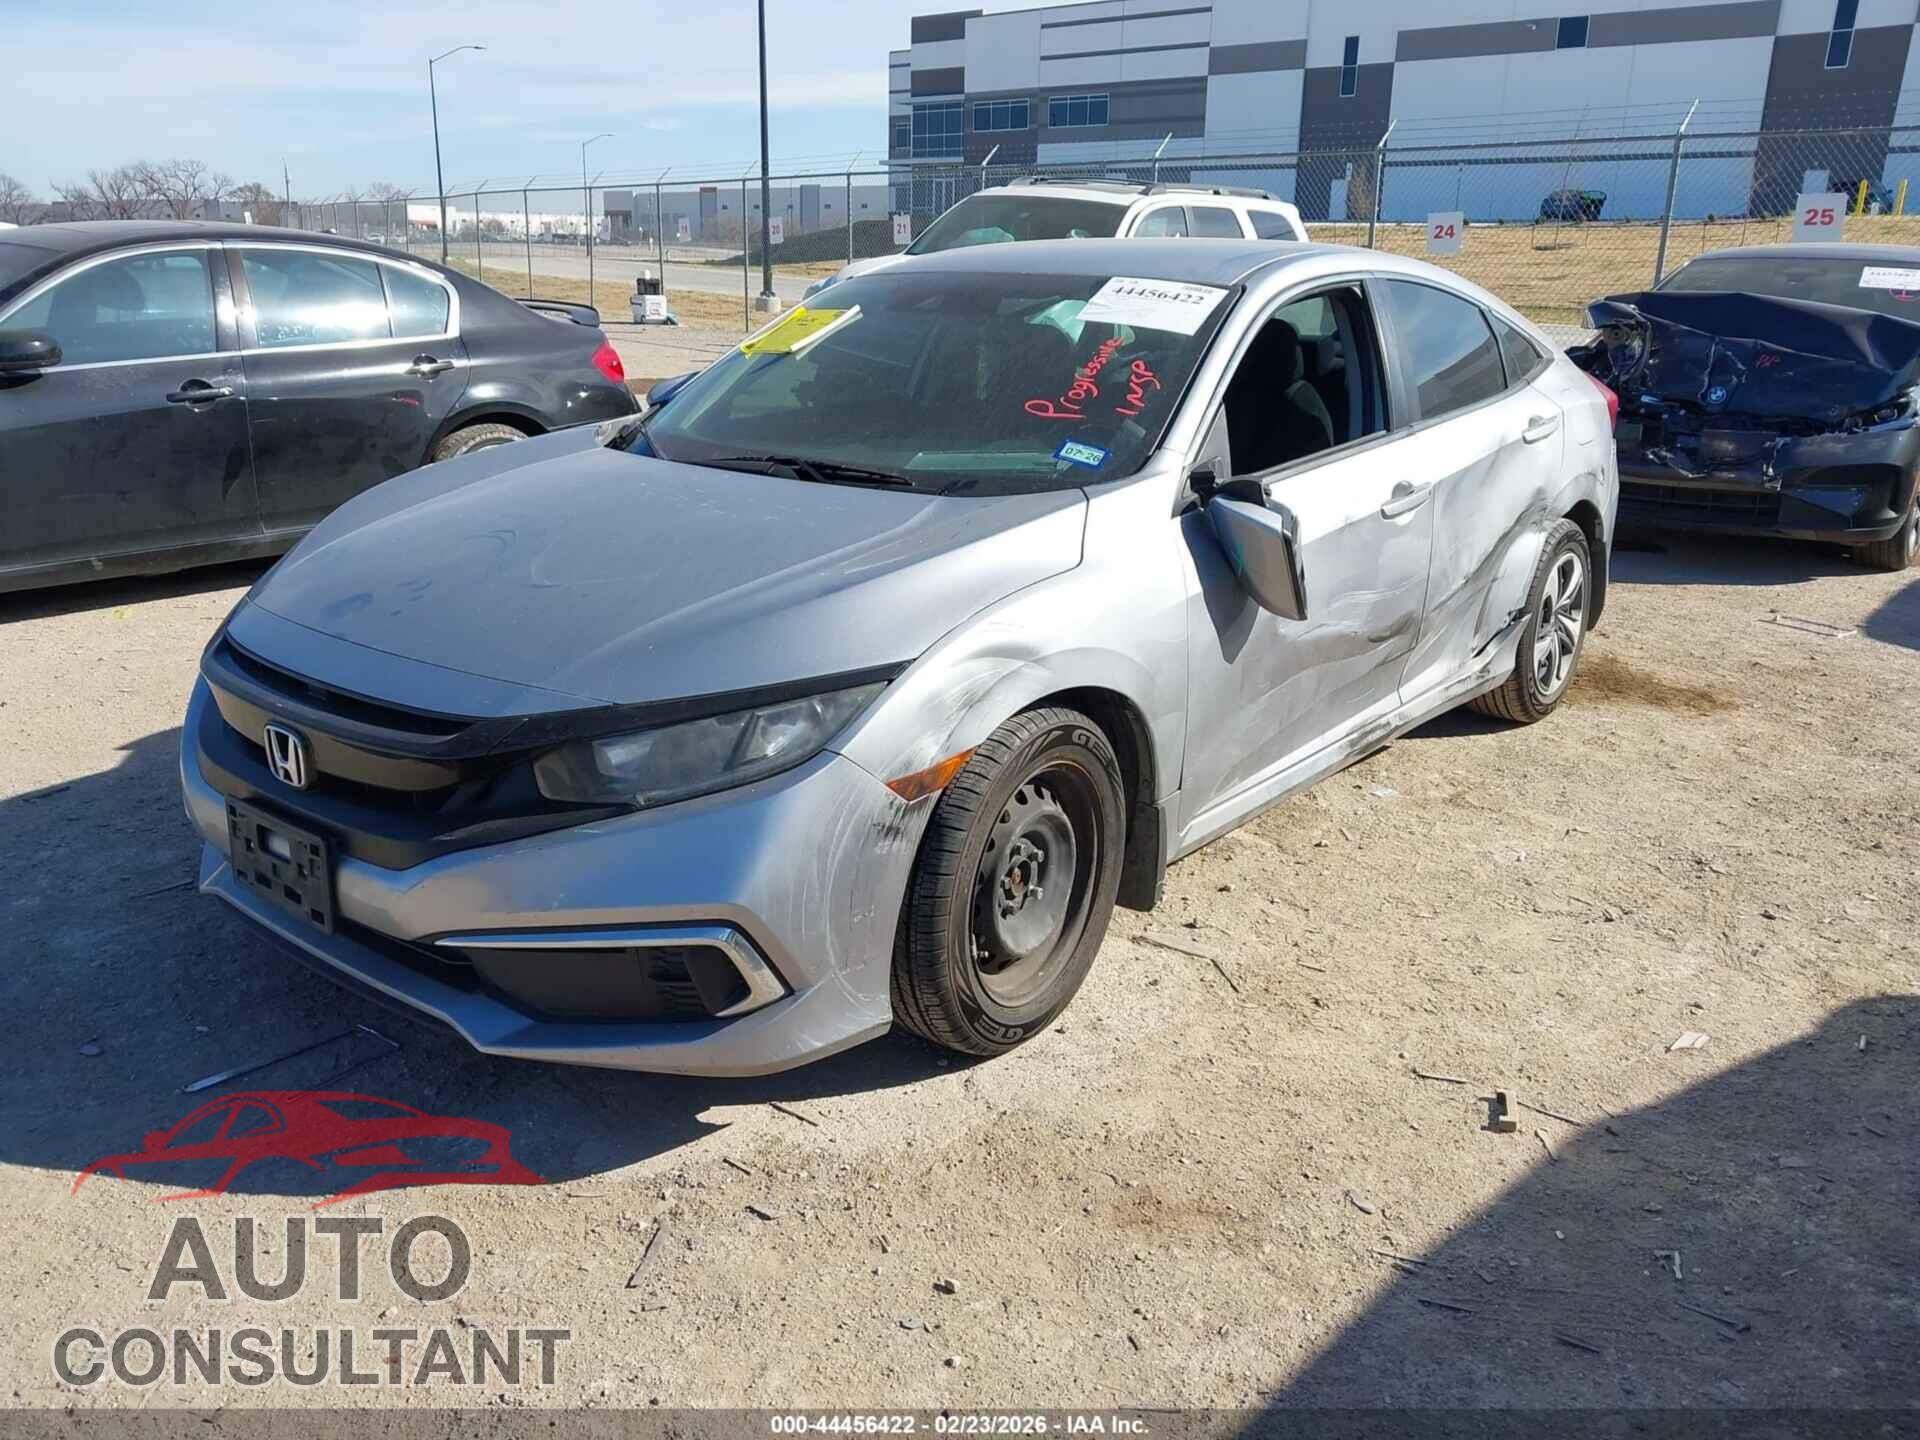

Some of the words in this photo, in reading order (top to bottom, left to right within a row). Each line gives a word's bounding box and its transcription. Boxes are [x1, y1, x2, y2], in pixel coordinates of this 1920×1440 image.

[1803, 208, 1834, 226] 25
[896, 223, 907, 234] 21
[1433, 224, 1456, 239] 24
[1112, 285, 1205, 305] 44456422
